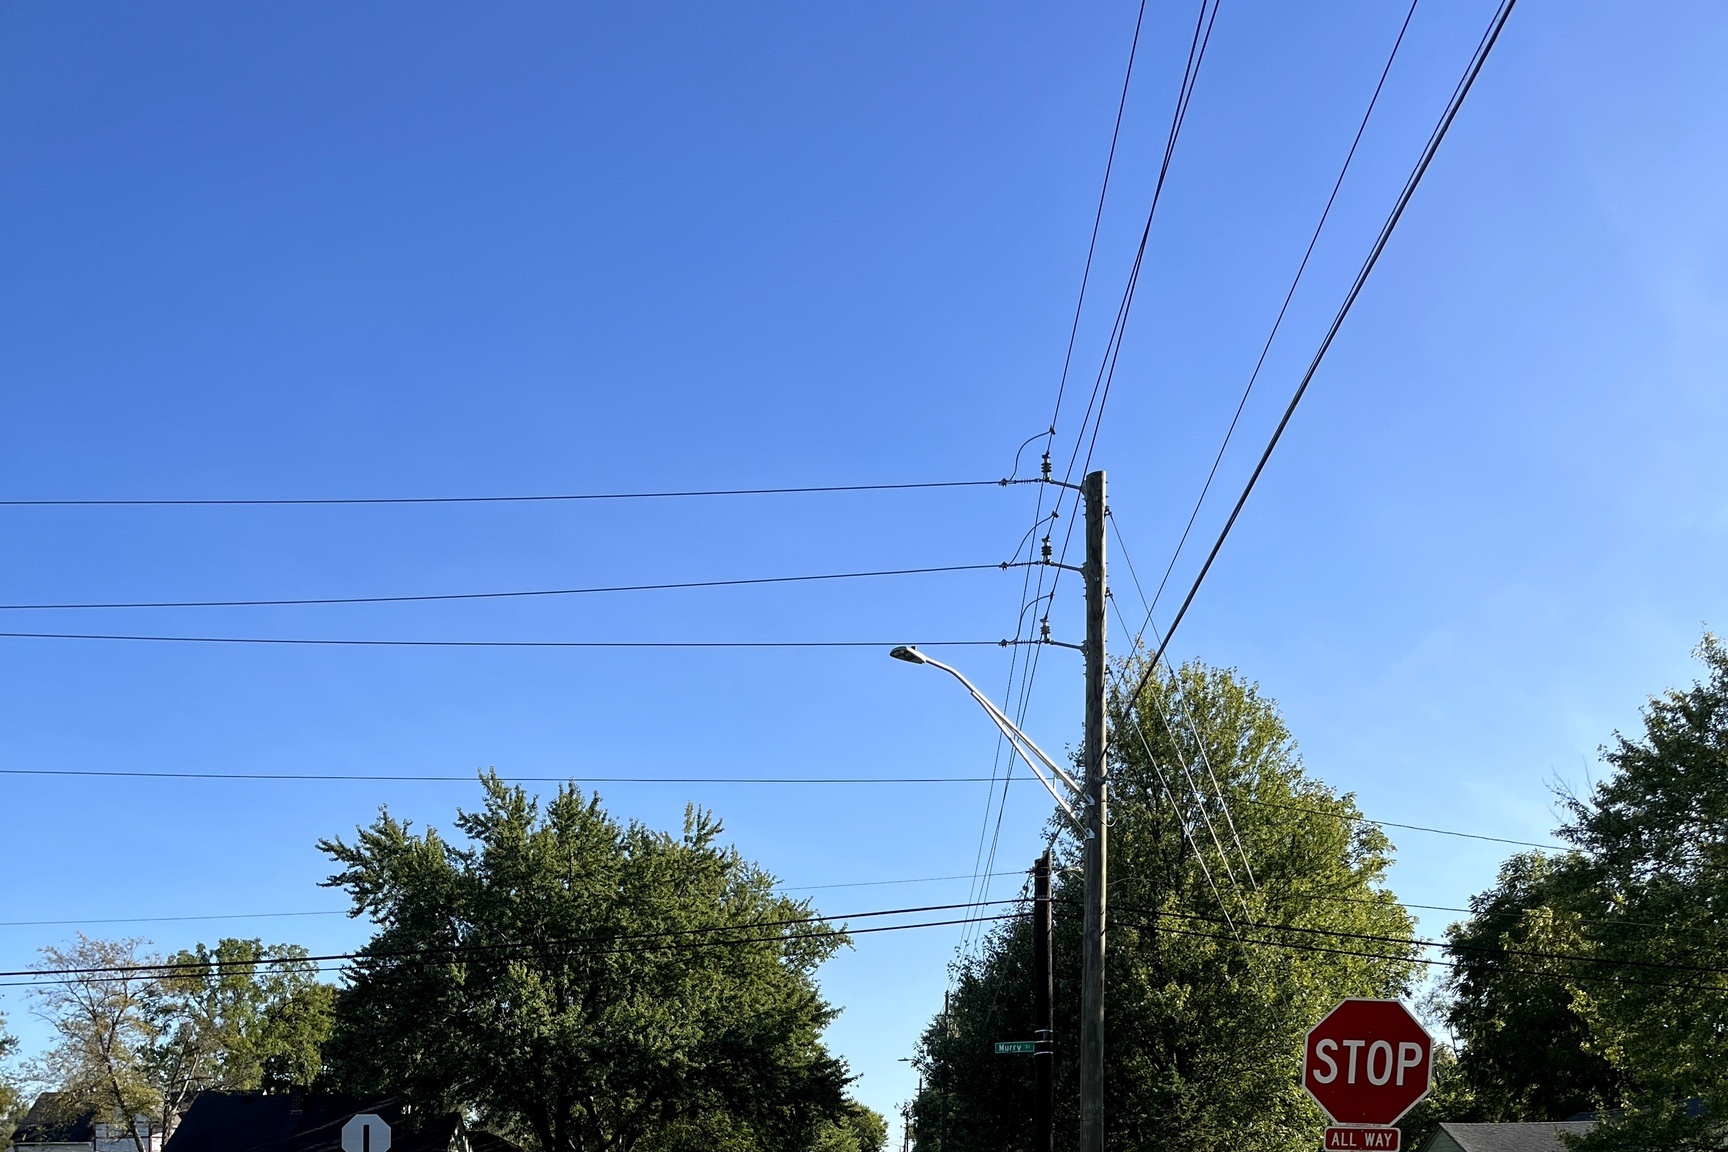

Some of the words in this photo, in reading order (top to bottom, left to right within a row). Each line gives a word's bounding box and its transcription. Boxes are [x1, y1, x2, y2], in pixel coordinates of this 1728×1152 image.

[998, 1044, 1022, 1052] Murry
[1313, 1038, 1423, 1086] STOP
[1331, 1132, 1357, 1147] ALL
[1364, 1133, 1393, 1147] WAY
